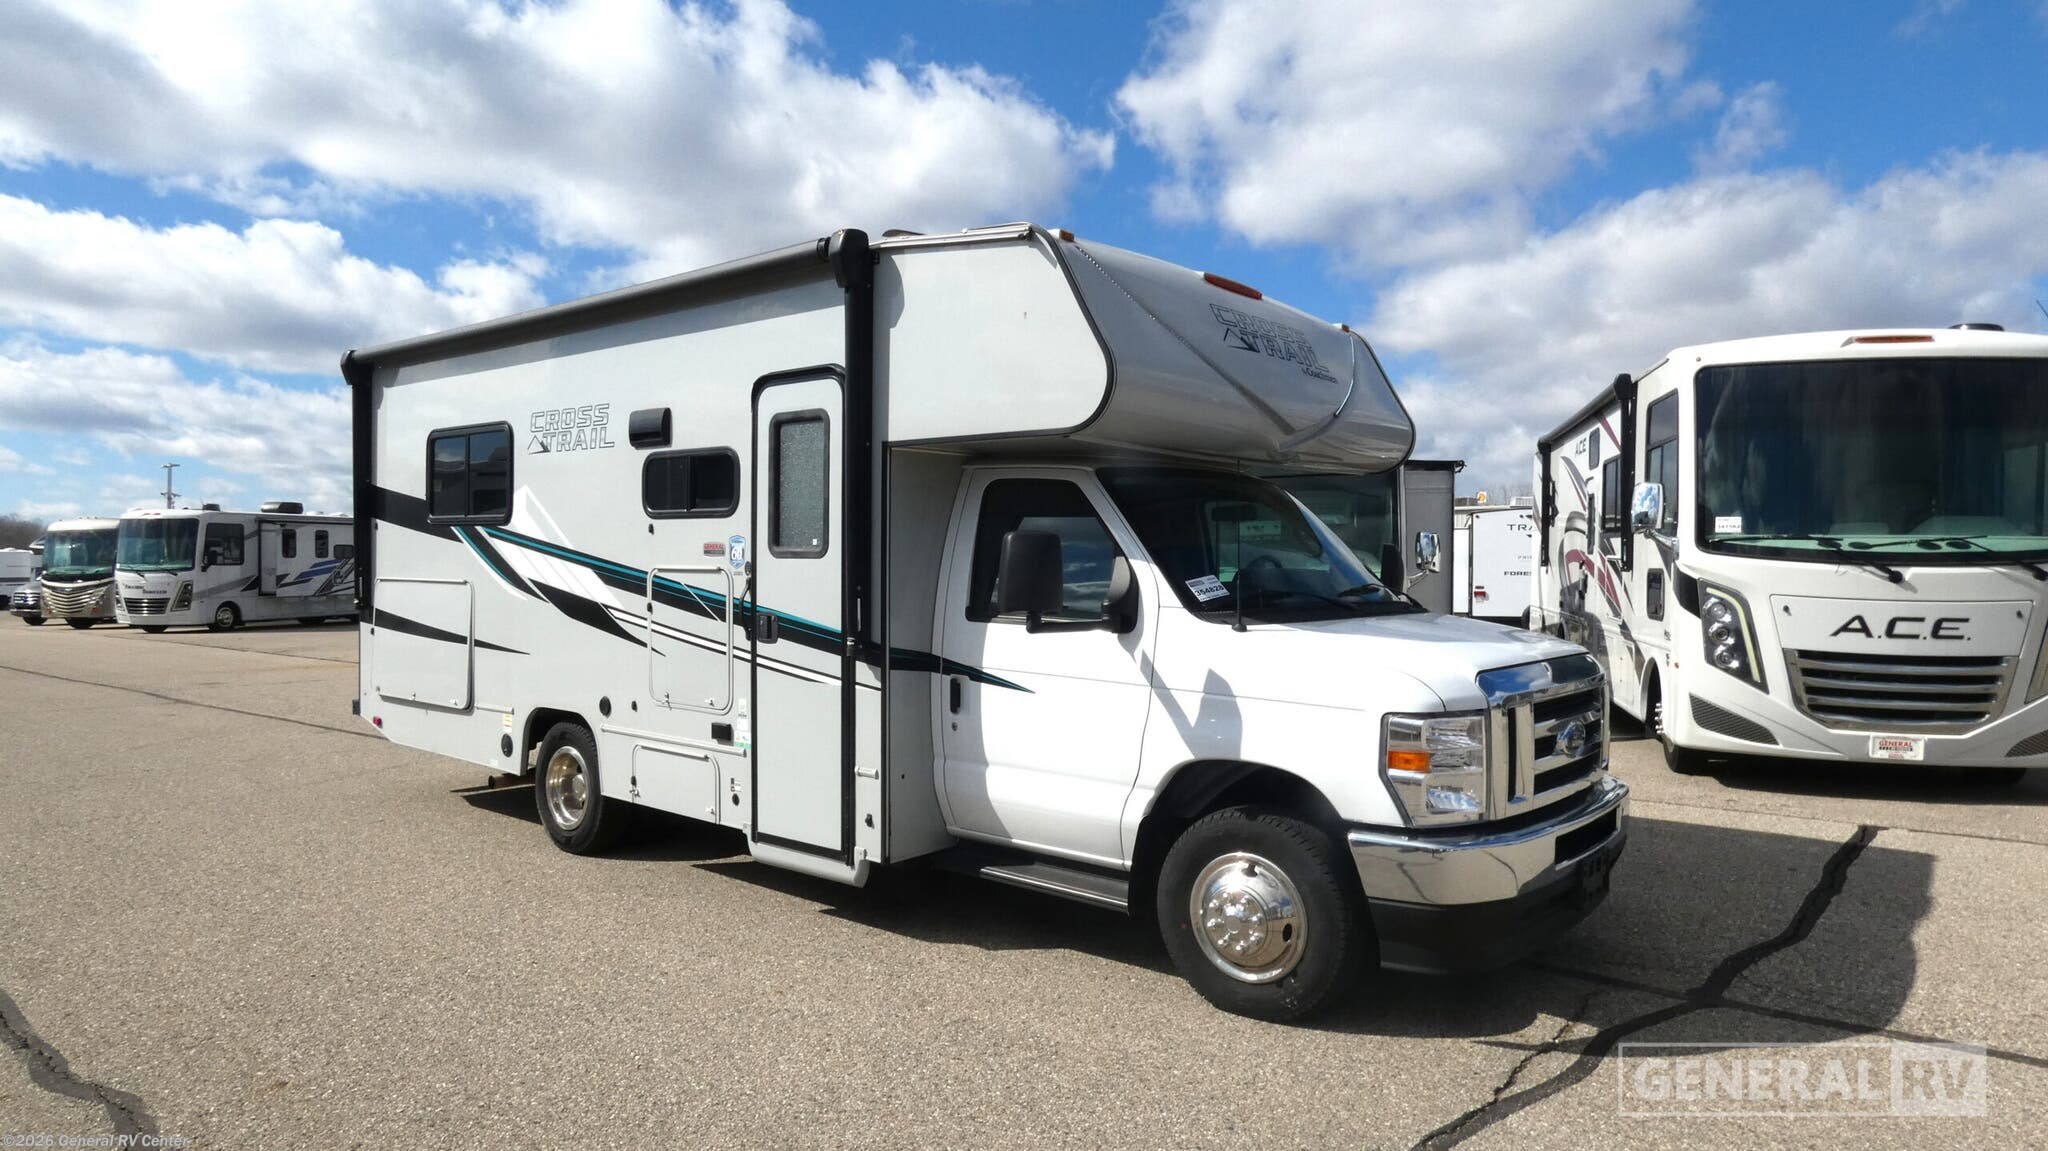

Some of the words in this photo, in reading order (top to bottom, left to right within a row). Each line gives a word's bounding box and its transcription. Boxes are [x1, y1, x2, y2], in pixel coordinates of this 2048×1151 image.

[1209, 303, 1311, 348] CROSS
[1239, 329, 1329, 372] TRAIL
[530, 403, 610, 433] CROSS
[543, 427, 615, 452] TRAIL
[1829, 614, 1971, 641] A.C.E.
